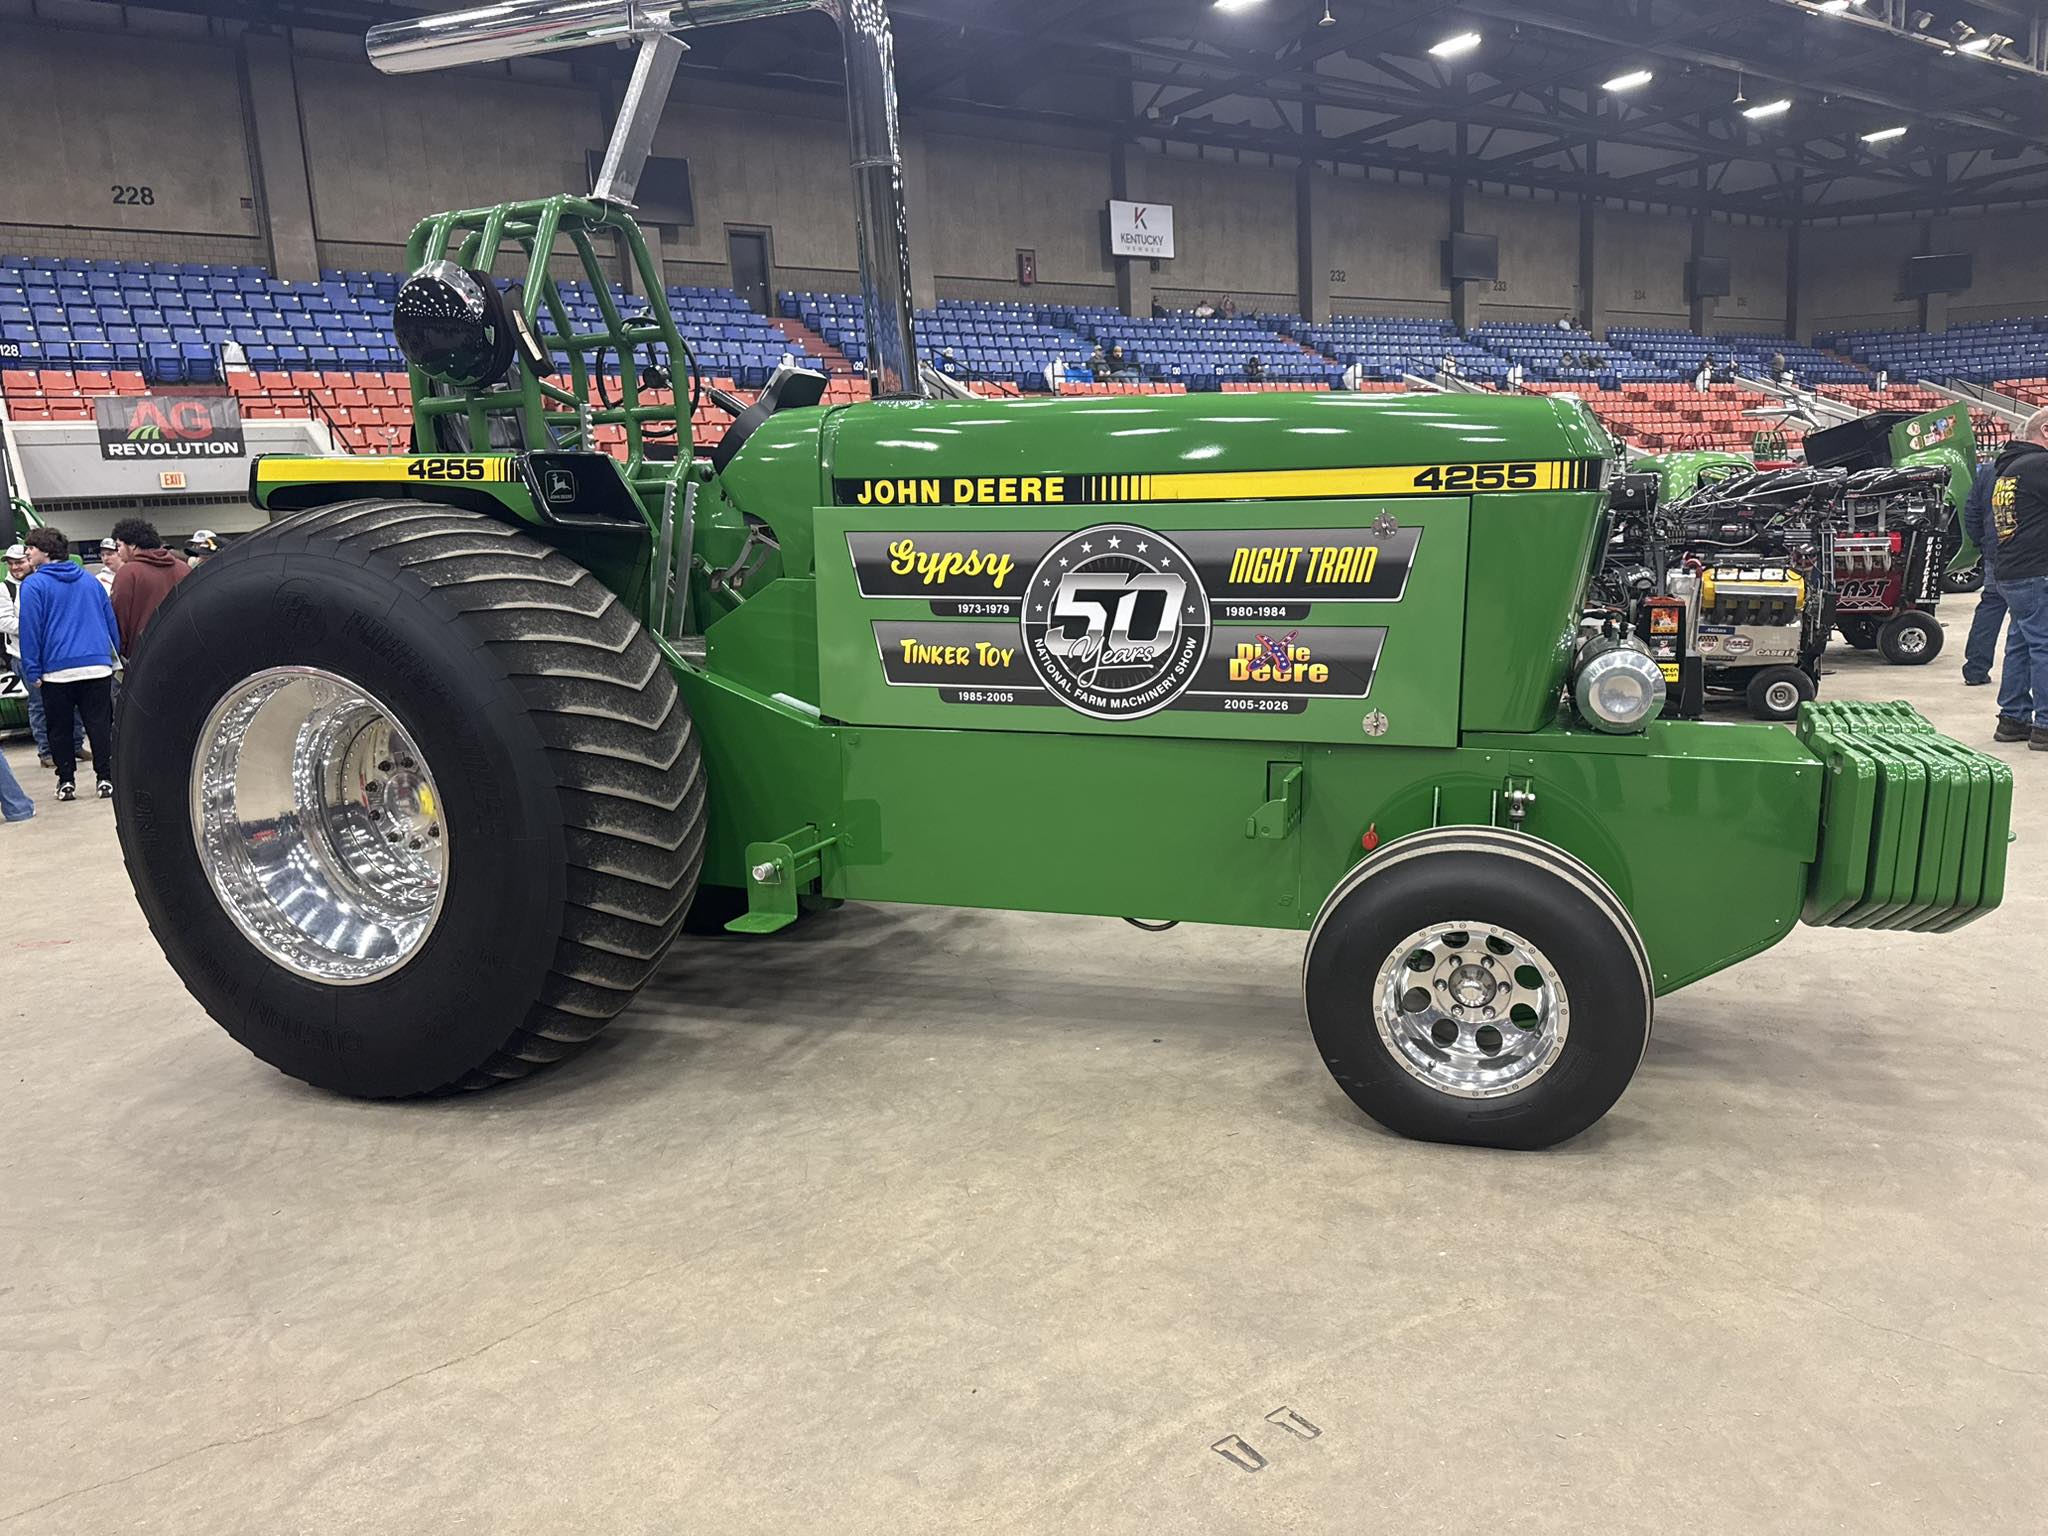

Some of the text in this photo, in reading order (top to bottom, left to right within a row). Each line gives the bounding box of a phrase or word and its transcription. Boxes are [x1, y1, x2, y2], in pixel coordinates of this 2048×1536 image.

[111, 185, 155, 206] 228
[1121, 233, 1164, 246] KENTUCKY
[1330, 270, 1346, 282] 232
[1493, 281, 1507, 291] 233
[127, 402, 213, 439] AG
[108, 441, 239, 456] REVOLUTION
[164, 473, 182, 486] EXIT
[407, 458, 485, 480] 4255
[1413, 464, 1536, 490] 4255
[857, 476, 1065, 504] JOHN DEERE
[888, 538, 1015, 589] Gypsy
[1228, 546, 1379, 583] NIGHT TRAIN
[1931, 536, 1943, 599] EQUIPMENT
[957, 604, 1010, 614] 1973-1979
[1044, 572, 1187, 658] 50
[1225, 606, 1286, 617] 1980-1984
[900, 639, 1015, 668] TINKER TOY
[1068, 635, 1155, 689] Years
[1034, 637, 1198, 709] NATIONAL FARM MACHINERY SHOW
[1229, 658, 1329, 683] Deere
[958, 691, 1014, 702] 1985-2005
[1224, 699, 1289, 711] 2005-2026
